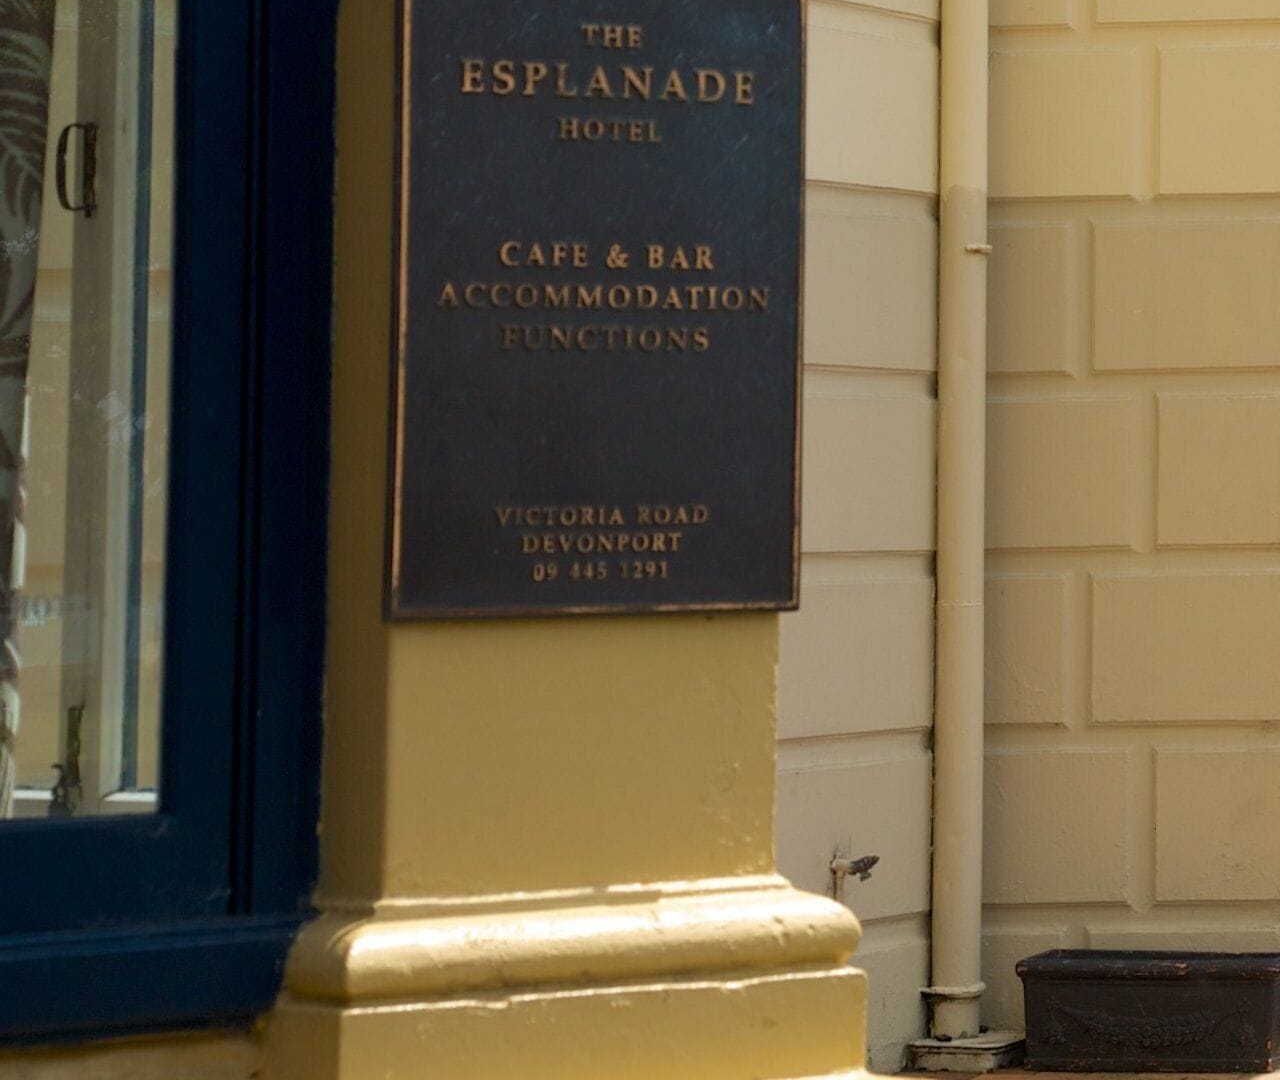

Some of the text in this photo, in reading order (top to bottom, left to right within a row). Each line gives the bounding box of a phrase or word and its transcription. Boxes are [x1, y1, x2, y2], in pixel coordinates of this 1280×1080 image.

[581, 24, 643, 49] THE
[461, 58, 754, 104] ESPLANADE
[559, 119, 662, 143] HOTEL
[500, 241, 714, 269] CAFE & BAR
[436, 283, 769, 310] ACCOMMODATION
[503, 325, 709, 352] FUNCTIONS
[495, 505, 709, 526] VICTORIA ROAD
[522, 532, 682, 554] DEVONPORT
[532, 561, 668, 581] 09 445 1291
